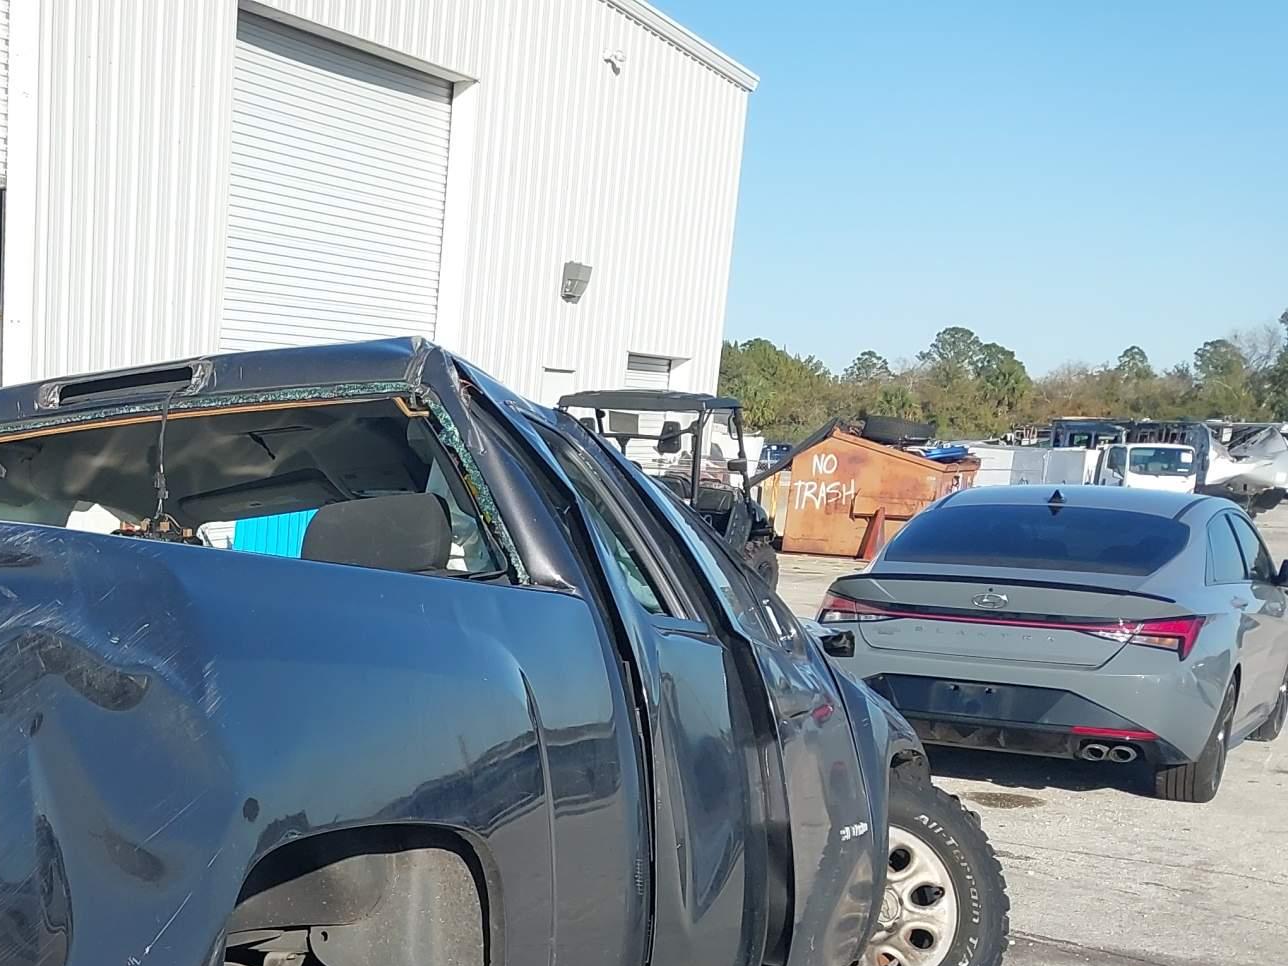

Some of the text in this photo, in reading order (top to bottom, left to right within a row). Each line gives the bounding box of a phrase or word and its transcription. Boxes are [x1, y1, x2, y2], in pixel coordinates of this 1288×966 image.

[812, 453, 839, 476] NO
[794, 478, 856, 511] TRASH
[913, 813, 982, 924] All-Terrain
